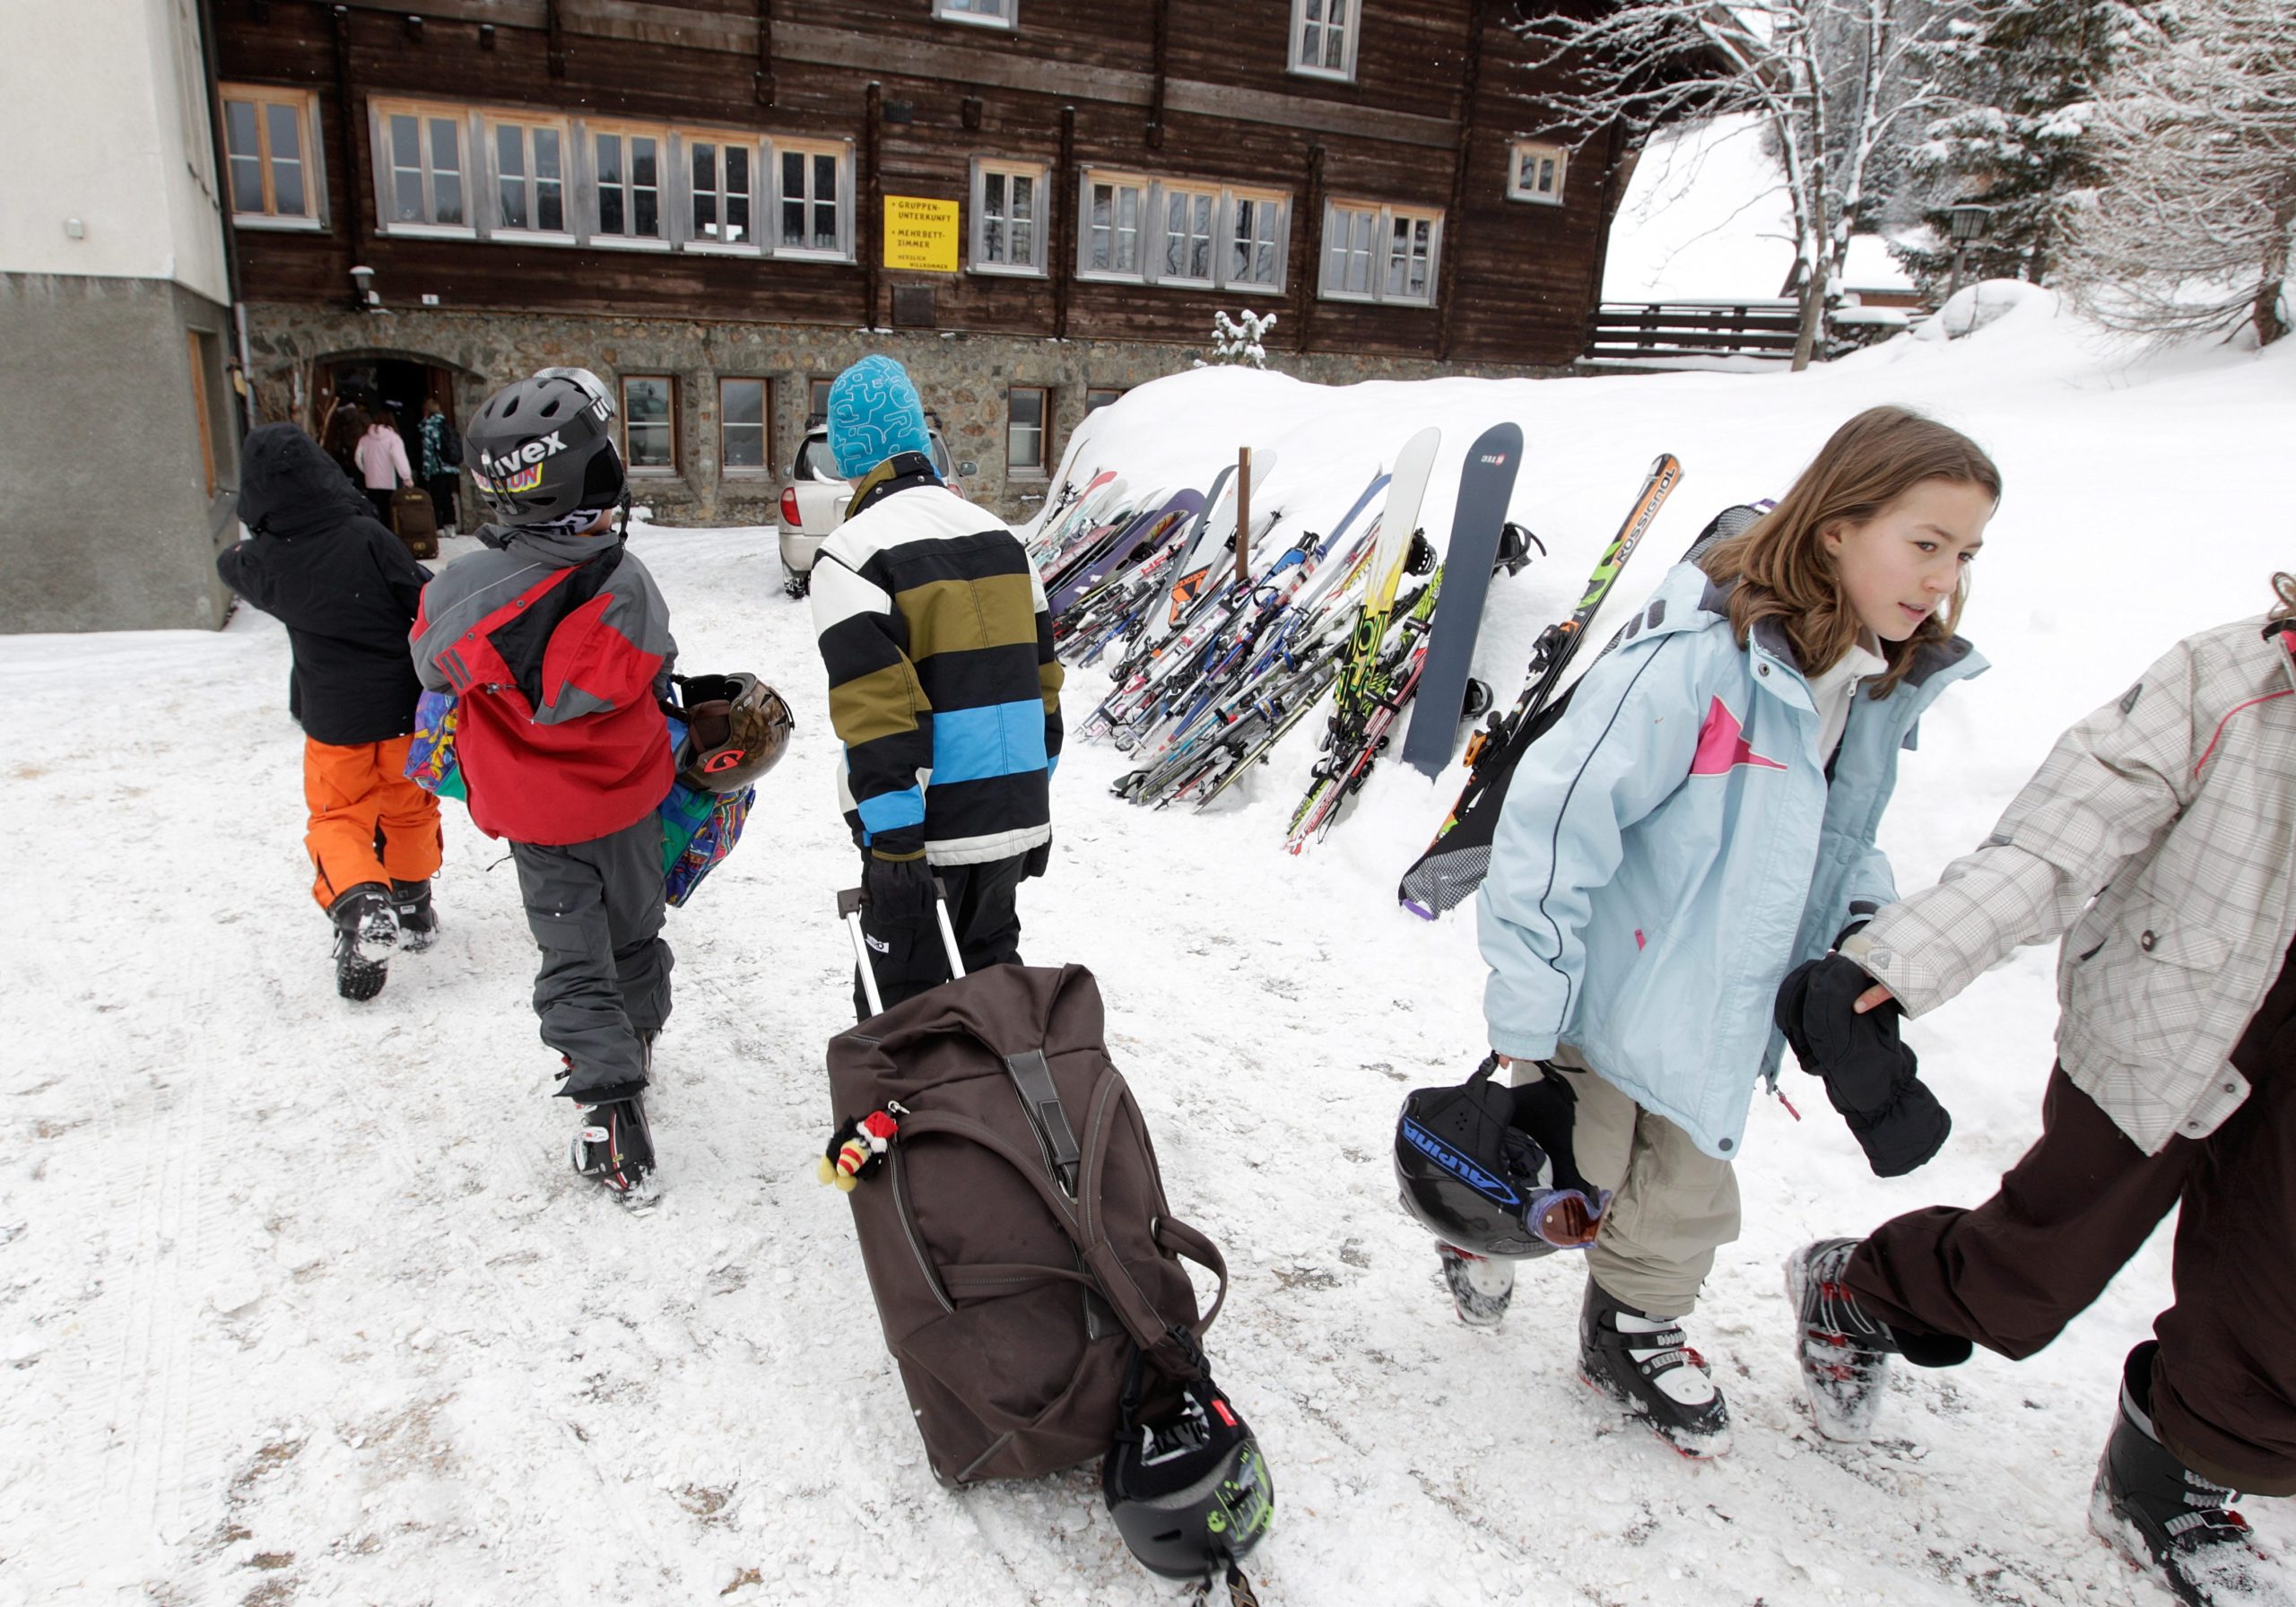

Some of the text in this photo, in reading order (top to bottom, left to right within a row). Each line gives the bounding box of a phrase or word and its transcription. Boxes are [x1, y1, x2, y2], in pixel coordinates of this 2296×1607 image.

[898, 201, 940, 211] GRUPPEN-
[898, 212, 951, 222] UNTERKUNFT
[898, 230, 945, 239] MEHRBETT-
[898, 239, 930, 248] ZIMMER
[1616, 466, 1675, 564] ROSSIGNOL
[1403, 1119, 1501, 1188] ALPINA
